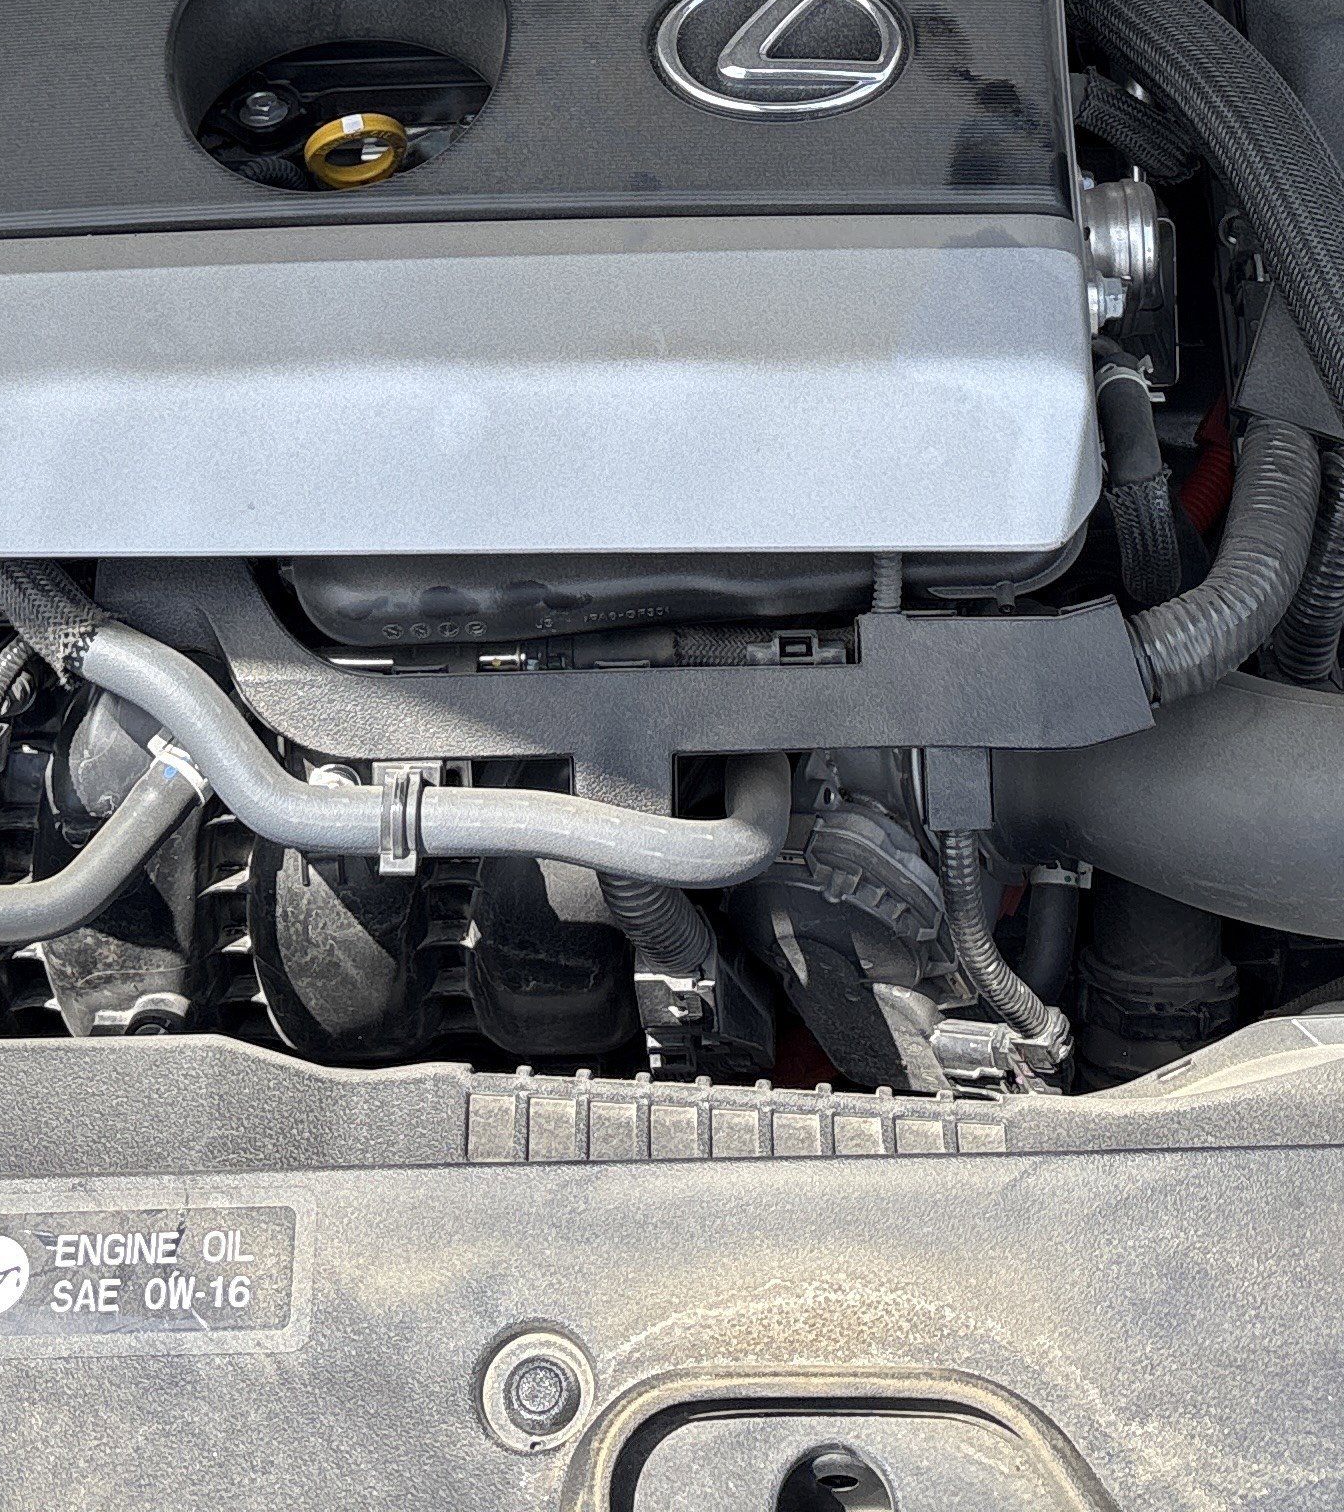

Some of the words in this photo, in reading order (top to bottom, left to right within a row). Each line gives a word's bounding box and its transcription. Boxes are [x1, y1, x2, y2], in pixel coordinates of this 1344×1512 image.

[54, 1231, 180, 1268] ENGINE
[201, 1230, 255, 1264] OIL
[50, 1277, 122, 1314] SAE
[144, 1273, 251, 1311] 0W-16
